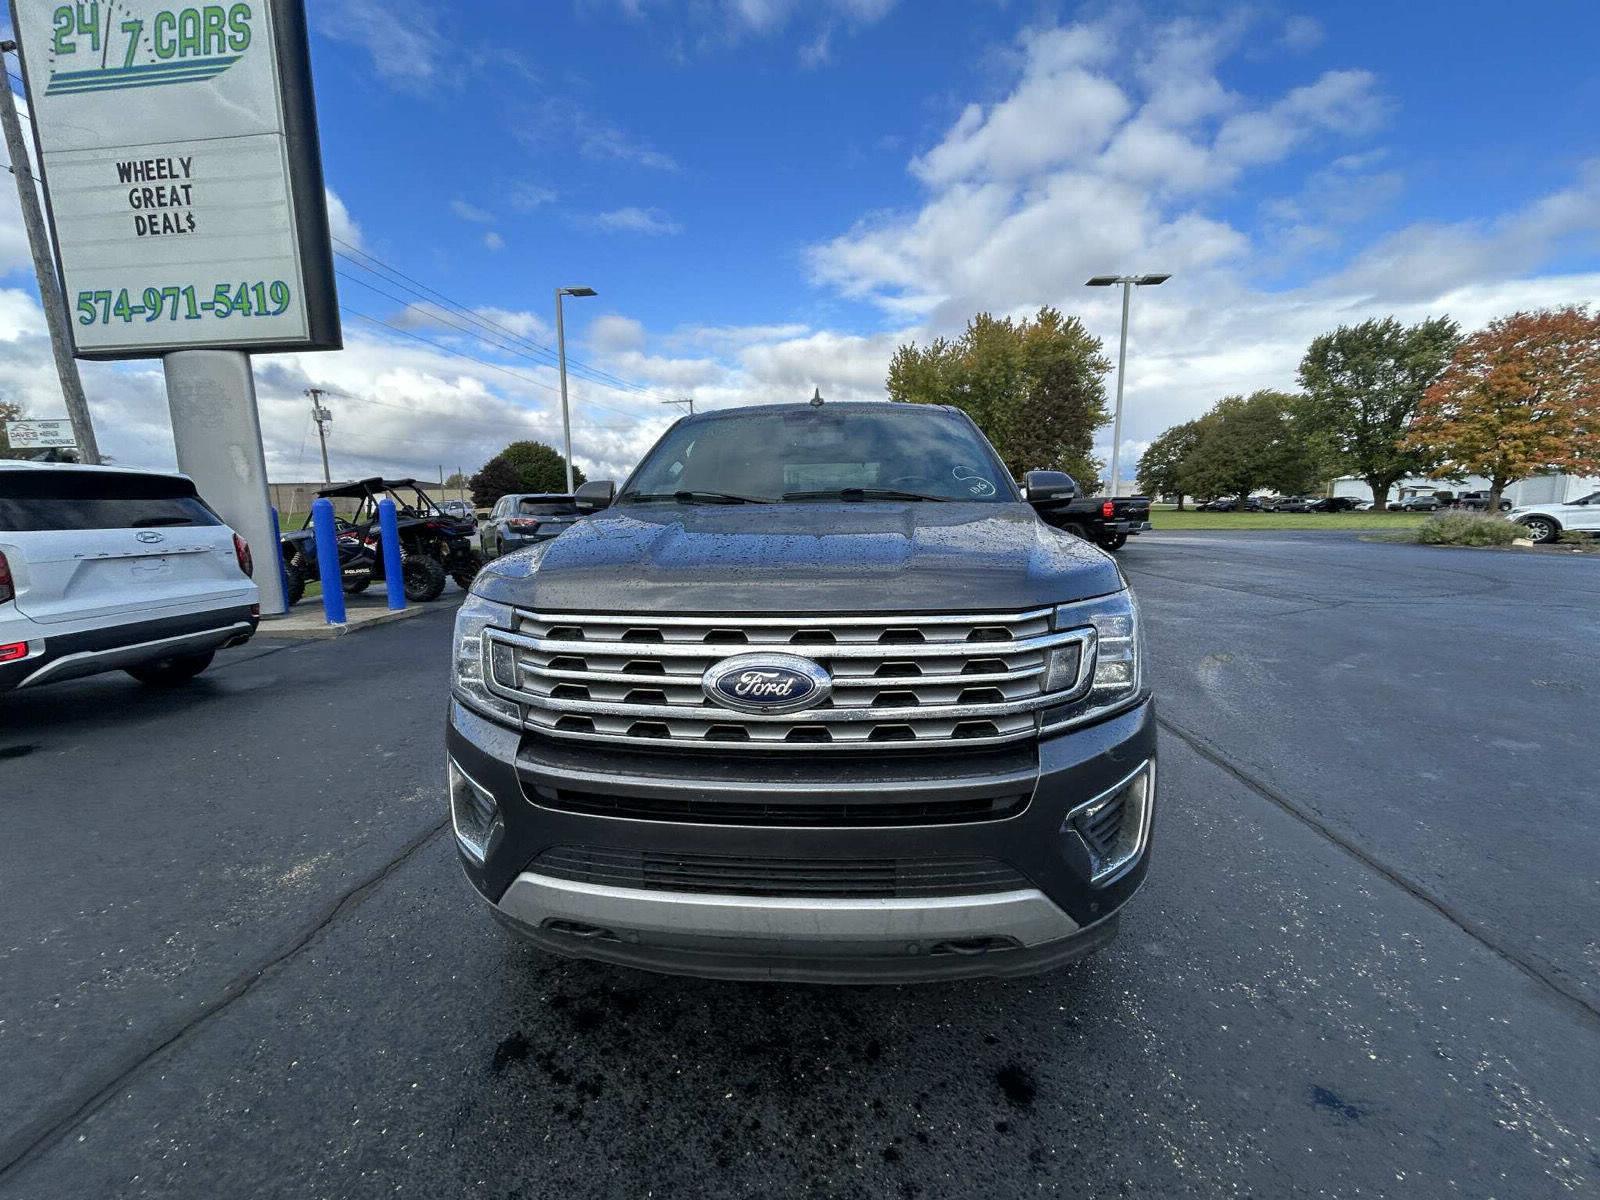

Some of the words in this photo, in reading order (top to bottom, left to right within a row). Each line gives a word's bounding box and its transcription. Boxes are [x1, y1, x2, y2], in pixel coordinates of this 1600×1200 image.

[154, 3, 252, 59] CARS
[116, 156, 192, 183] WHEELY
[128, 184, 193, 209] GREAT
[134, 211, 196, 236] DEAL$
[76, 280, 290, 325] 574-971-5419
[734, 671, 793, 696] Ford
